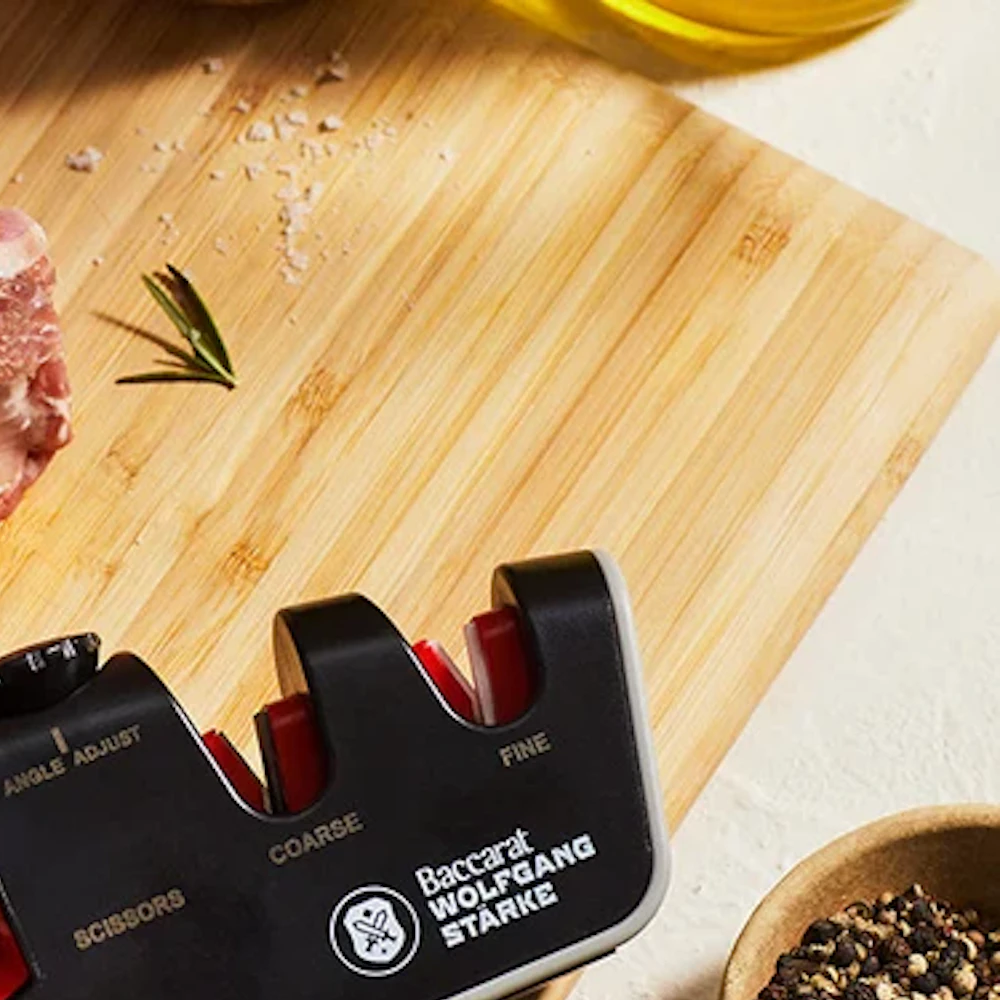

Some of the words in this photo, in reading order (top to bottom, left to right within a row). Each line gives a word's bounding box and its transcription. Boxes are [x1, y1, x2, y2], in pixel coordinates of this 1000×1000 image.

[2, 757, 67, 797] ANGLE
[70, 724, 144, 768] ADJUST
[498, 732, 552, 768] FINE
[267, 811, 366, 867] COARSE
[415, 827, 534, 897] Baccarat
[427, 834, 597, 921] WOLFGANG
[73, 888, 186, 951] SCISSORS
